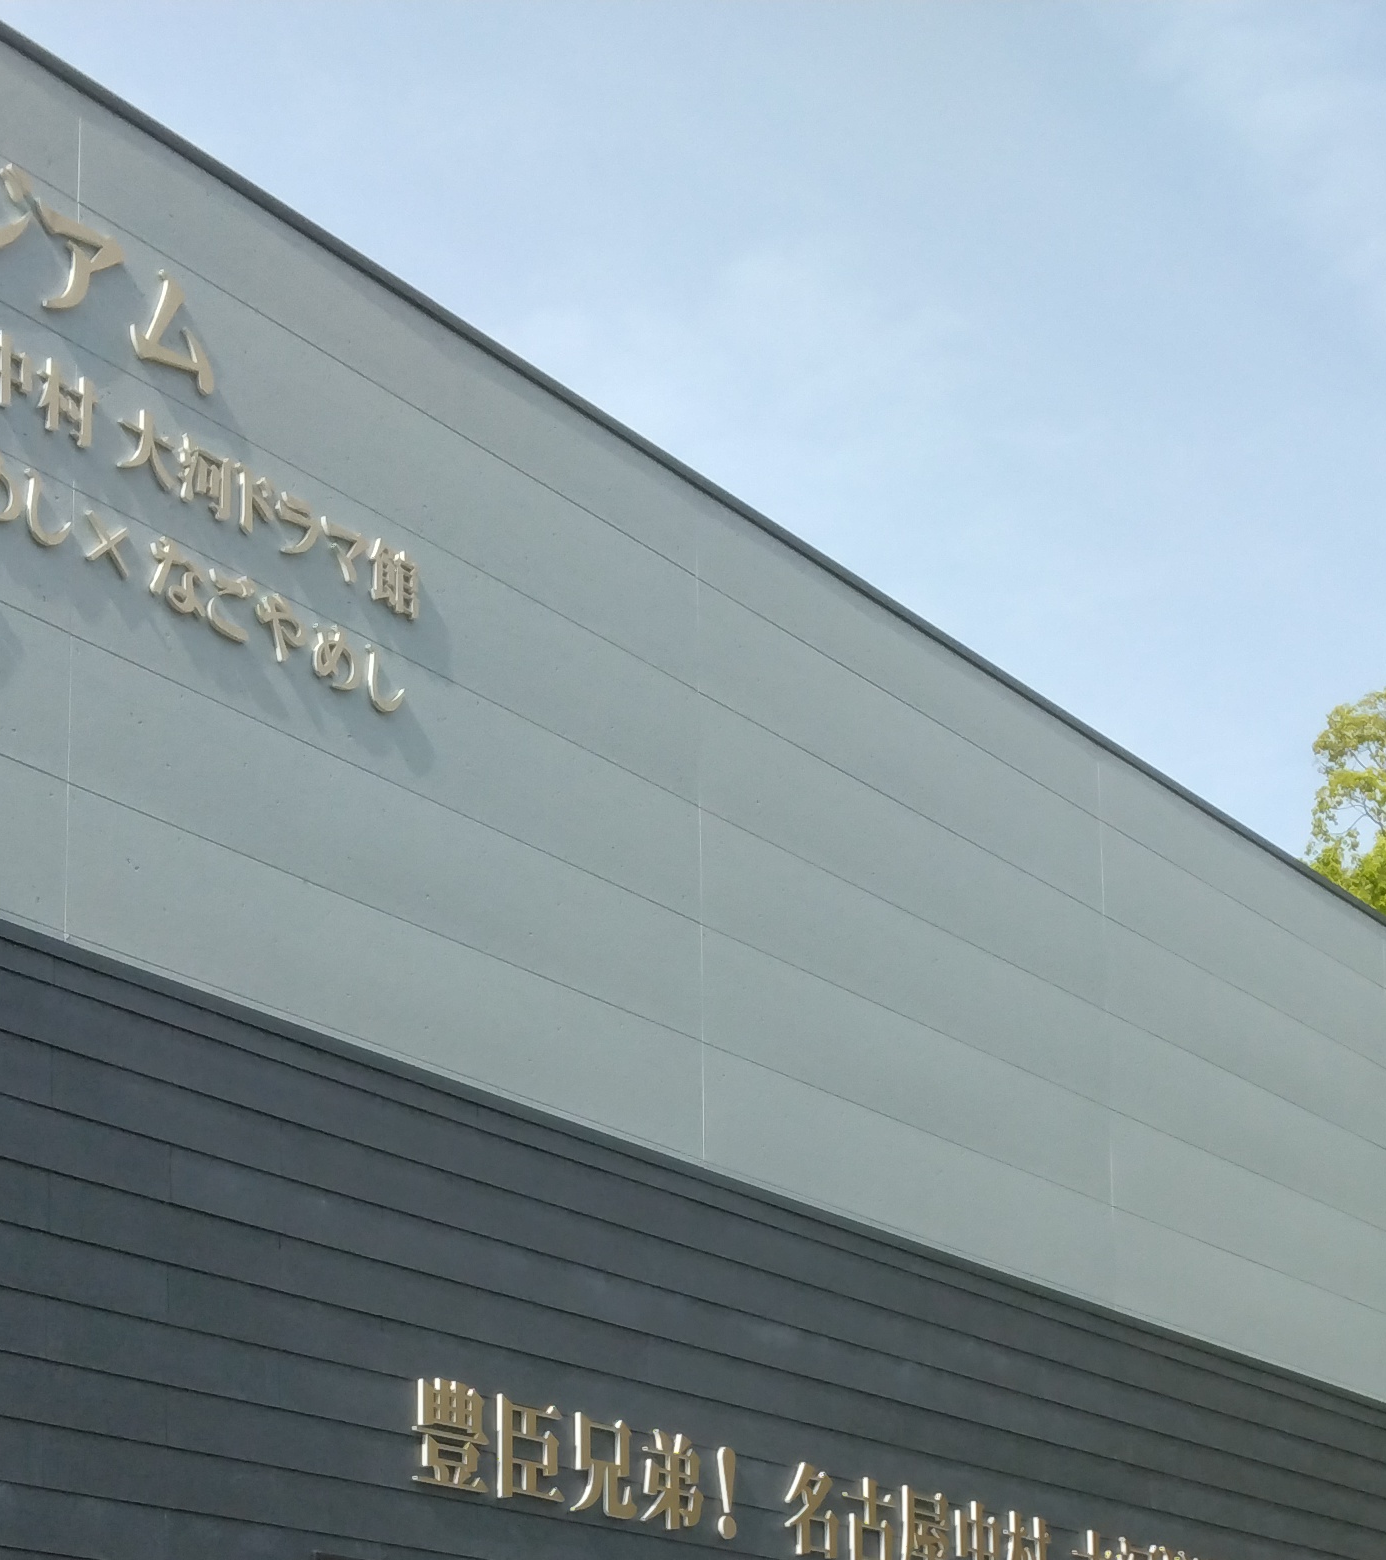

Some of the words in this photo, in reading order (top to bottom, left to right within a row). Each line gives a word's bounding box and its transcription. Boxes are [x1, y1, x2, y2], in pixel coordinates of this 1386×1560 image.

[116, 408, 420, 620] 大河ドラマ館
